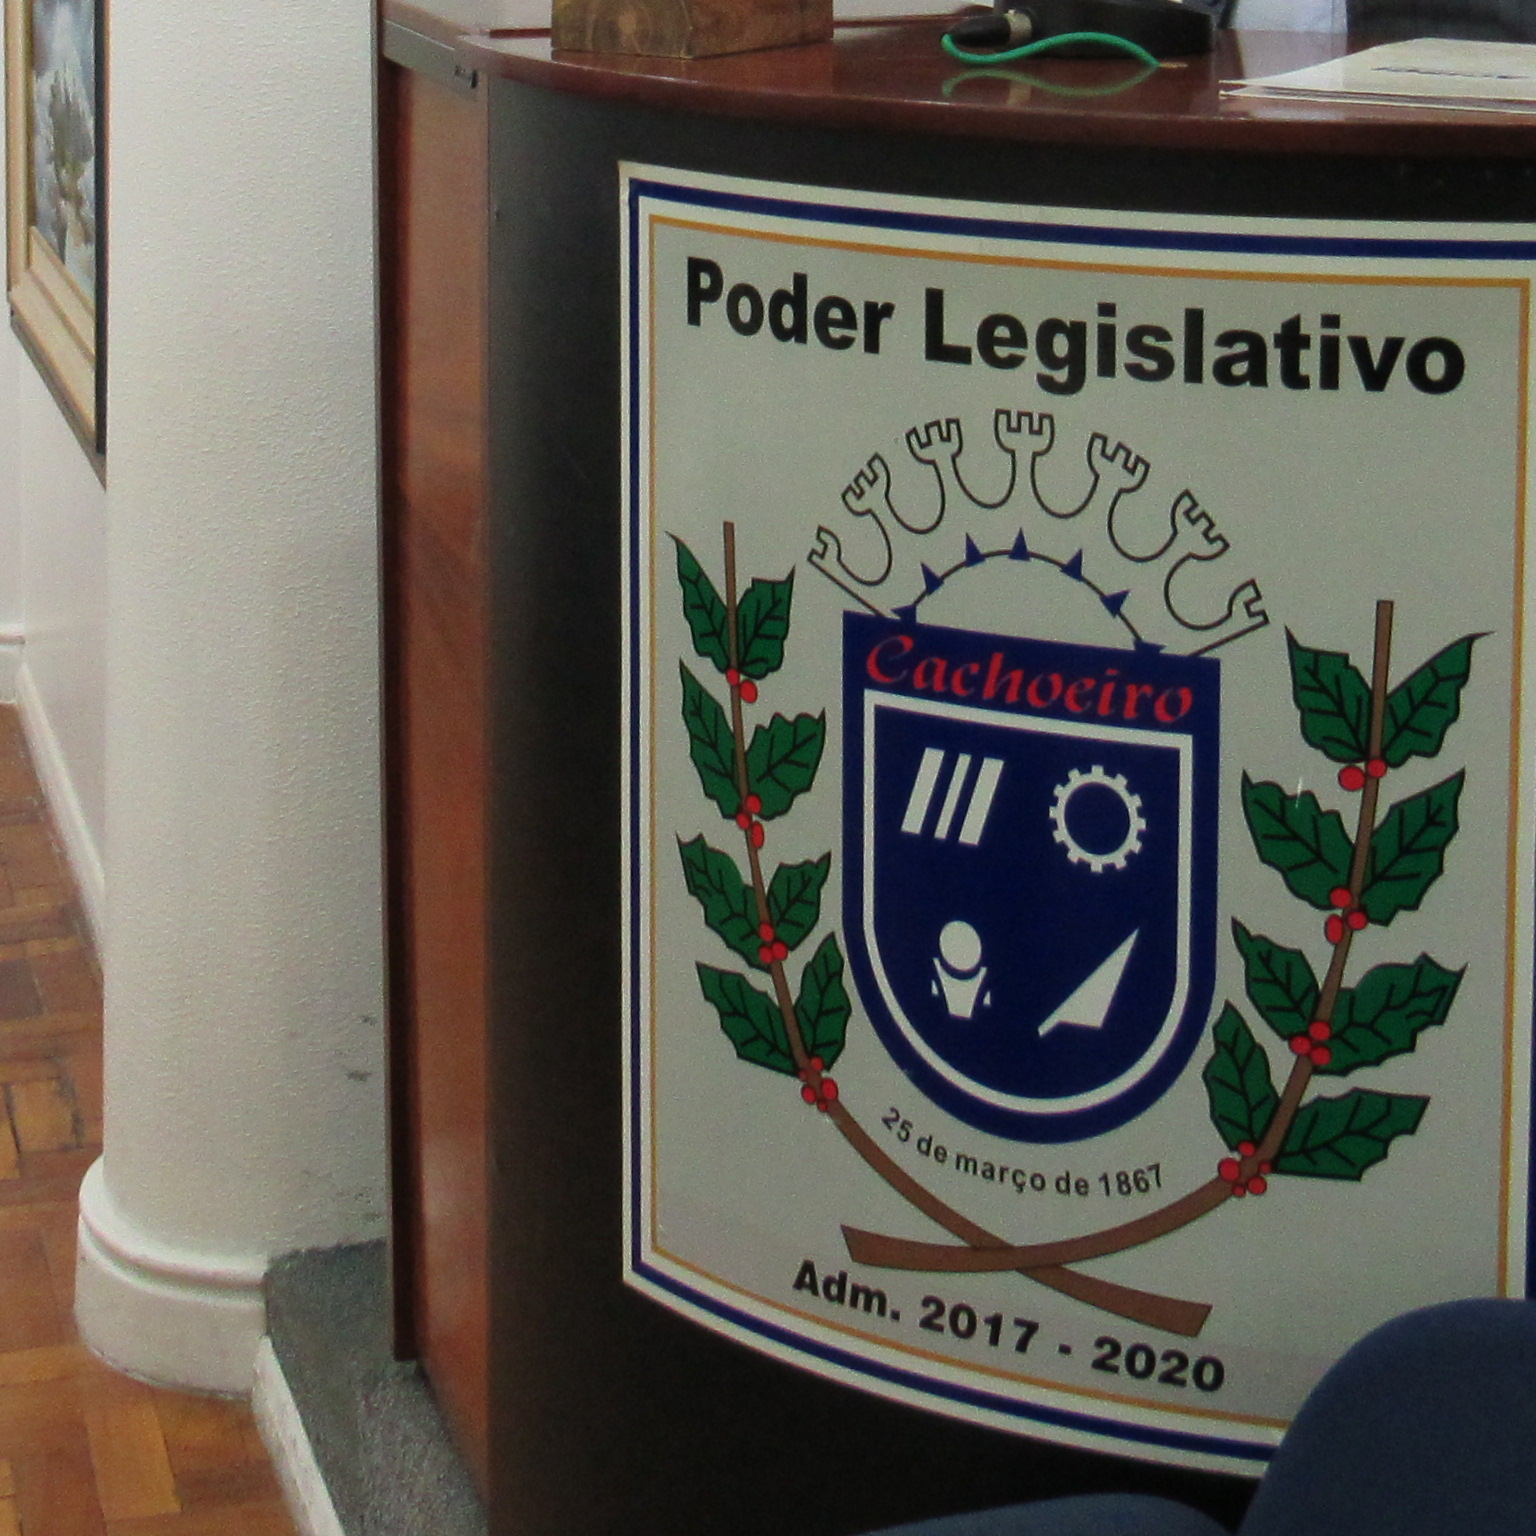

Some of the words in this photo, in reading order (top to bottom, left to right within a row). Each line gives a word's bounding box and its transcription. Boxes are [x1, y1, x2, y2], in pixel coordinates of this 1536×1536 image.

[686, 256, 896, 355] Poder
[924, 287, 1467, 396] Legislativo
[866, 634, 1194, 723] Cachoeiro
[880, 1106, 914, 1144] 25
[916, 1133, 949, 1166] de
[954, 1151, 1047, 1196] março
[1054, 1169, 1090, 1199] de
[1097, 1161, 1162, 1198] 1867
[792, 1259, 902, 1323] Adm.
[918, 1294, 1040, 1355] 2017
[1090, 1335, 1226, 1397] 2020
